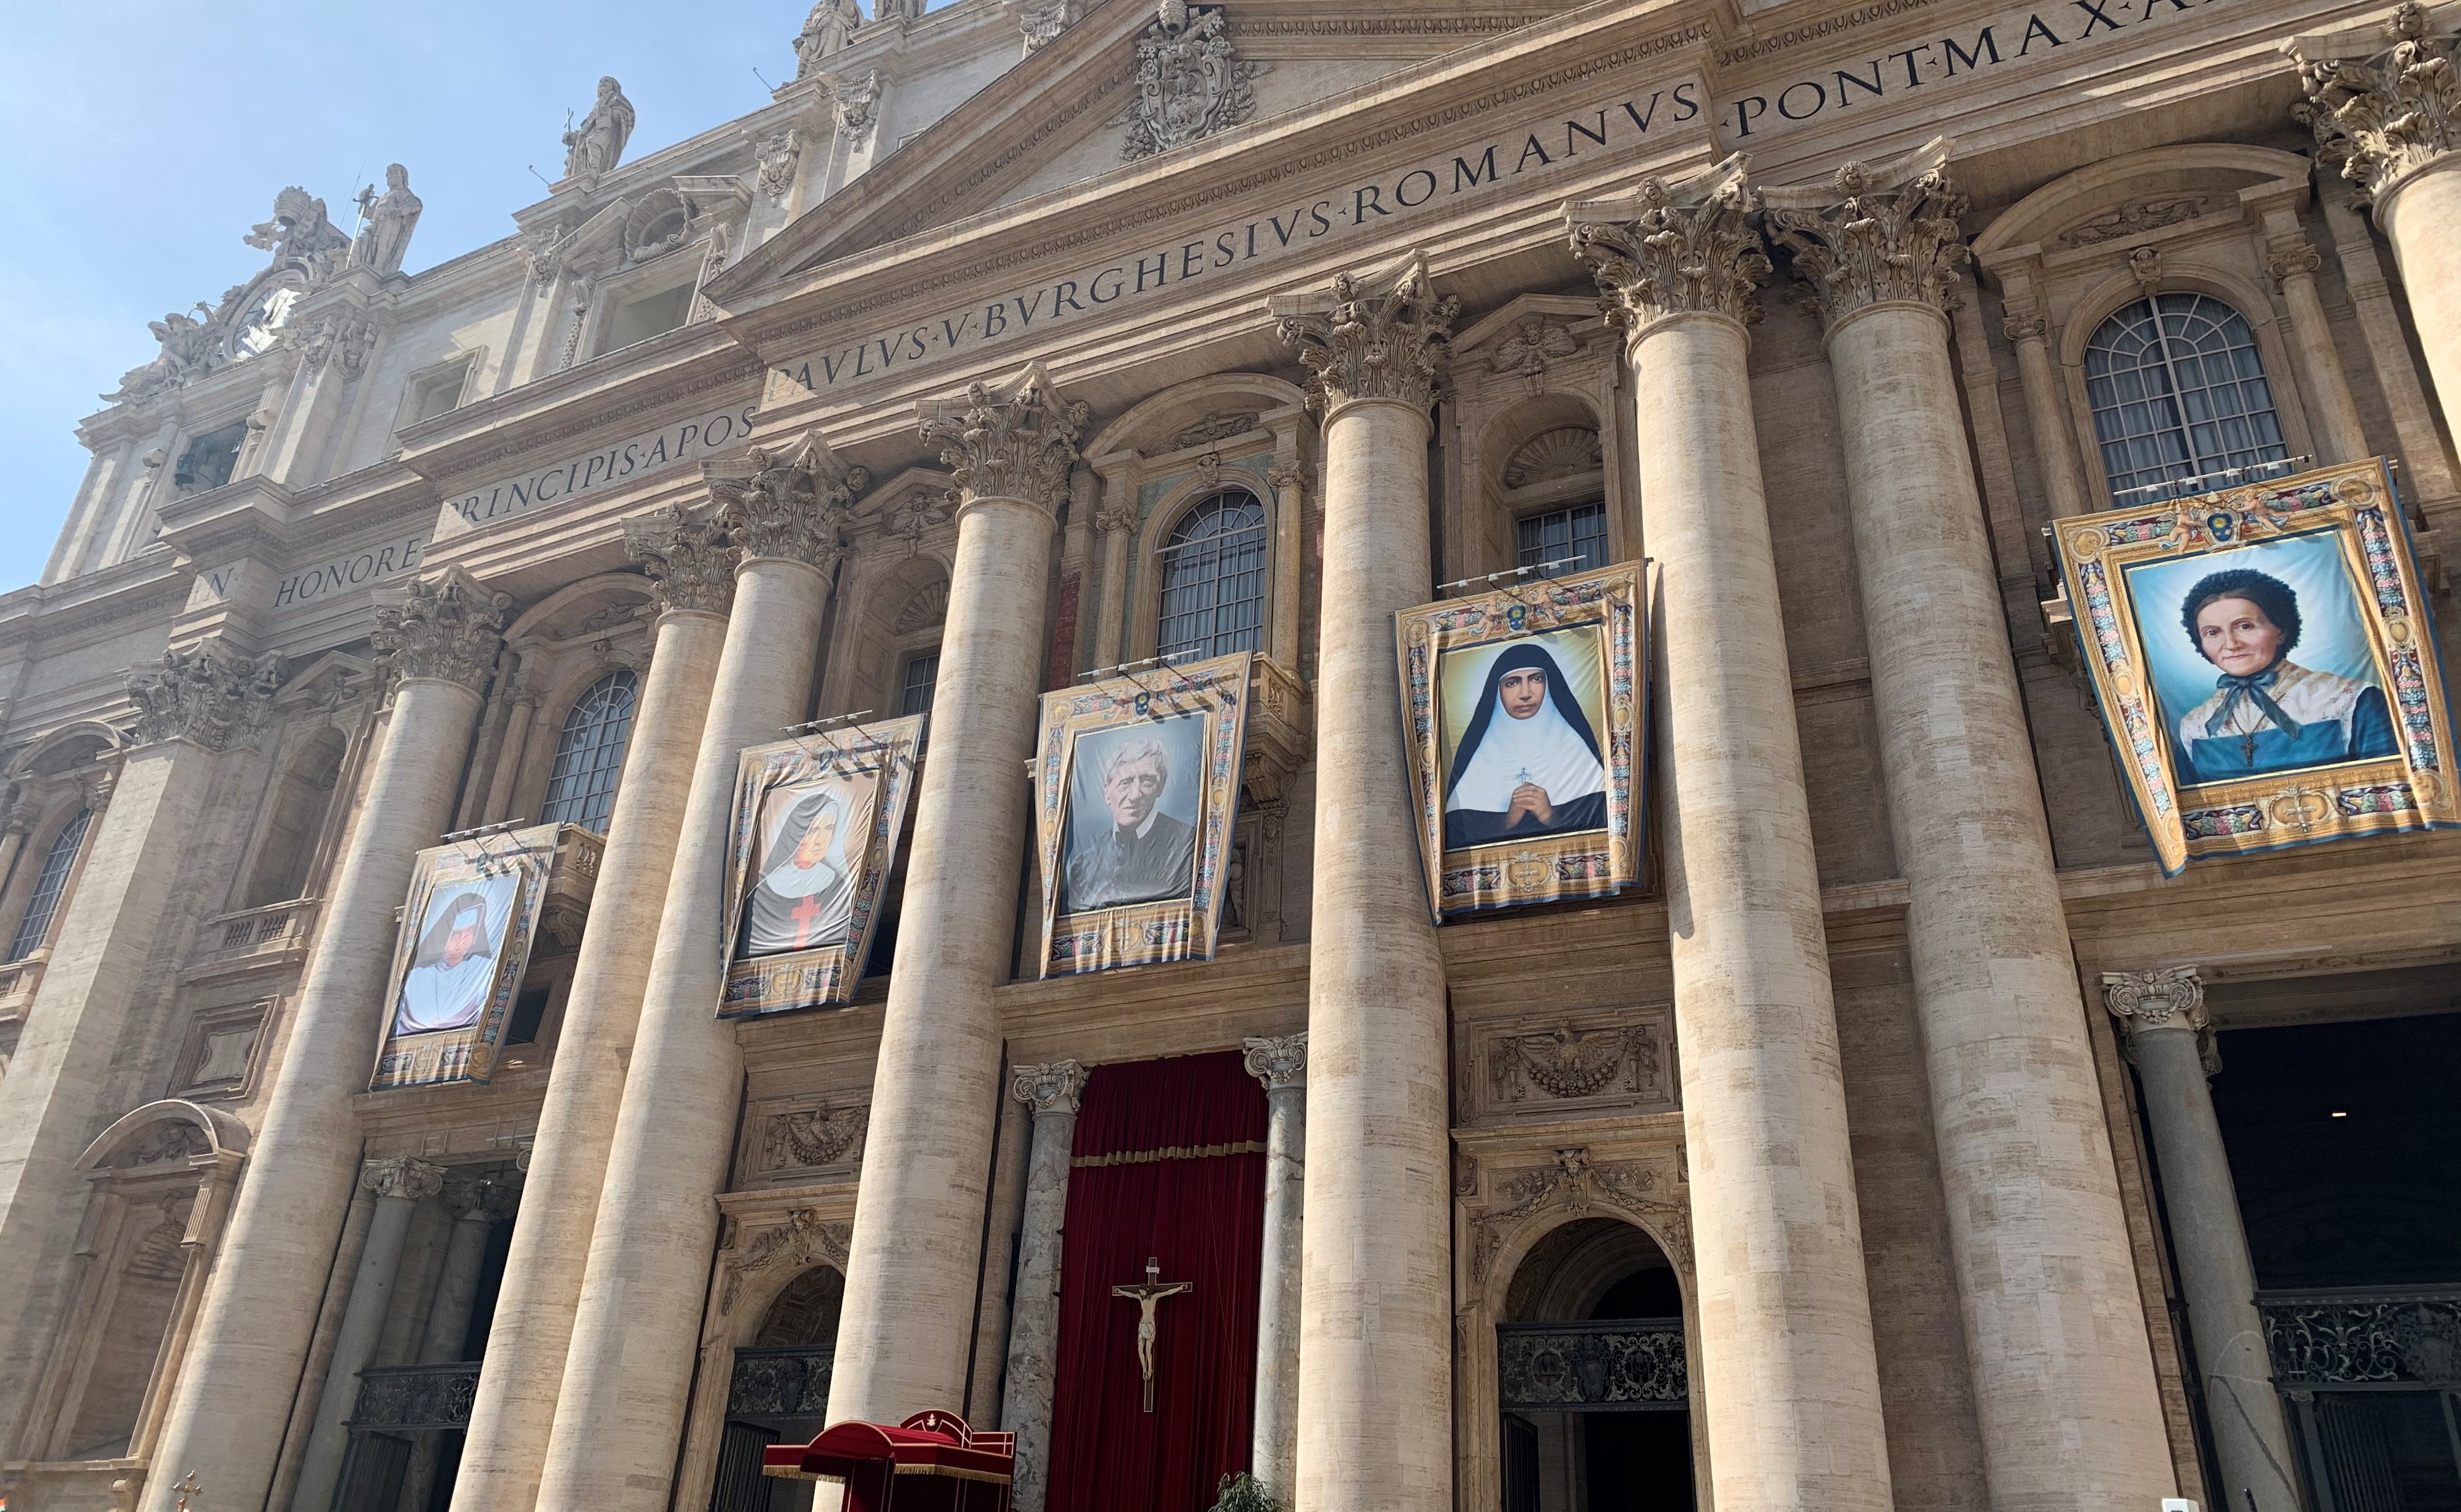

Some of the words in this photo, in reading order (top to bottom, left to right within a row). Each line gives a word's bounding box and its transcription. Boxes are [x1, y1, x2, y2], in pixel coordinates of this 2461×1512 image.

[272, 531, 435, 608] HONORE
[940, 311, 973, 349] V
[981, 200, 1331, 340] BVRGHESIVS
[1352, 82, 1700, 227] ROMANVS
[1732, 43, 1930, 139] PONT
[1938, 0, 2128, 78] MAX
